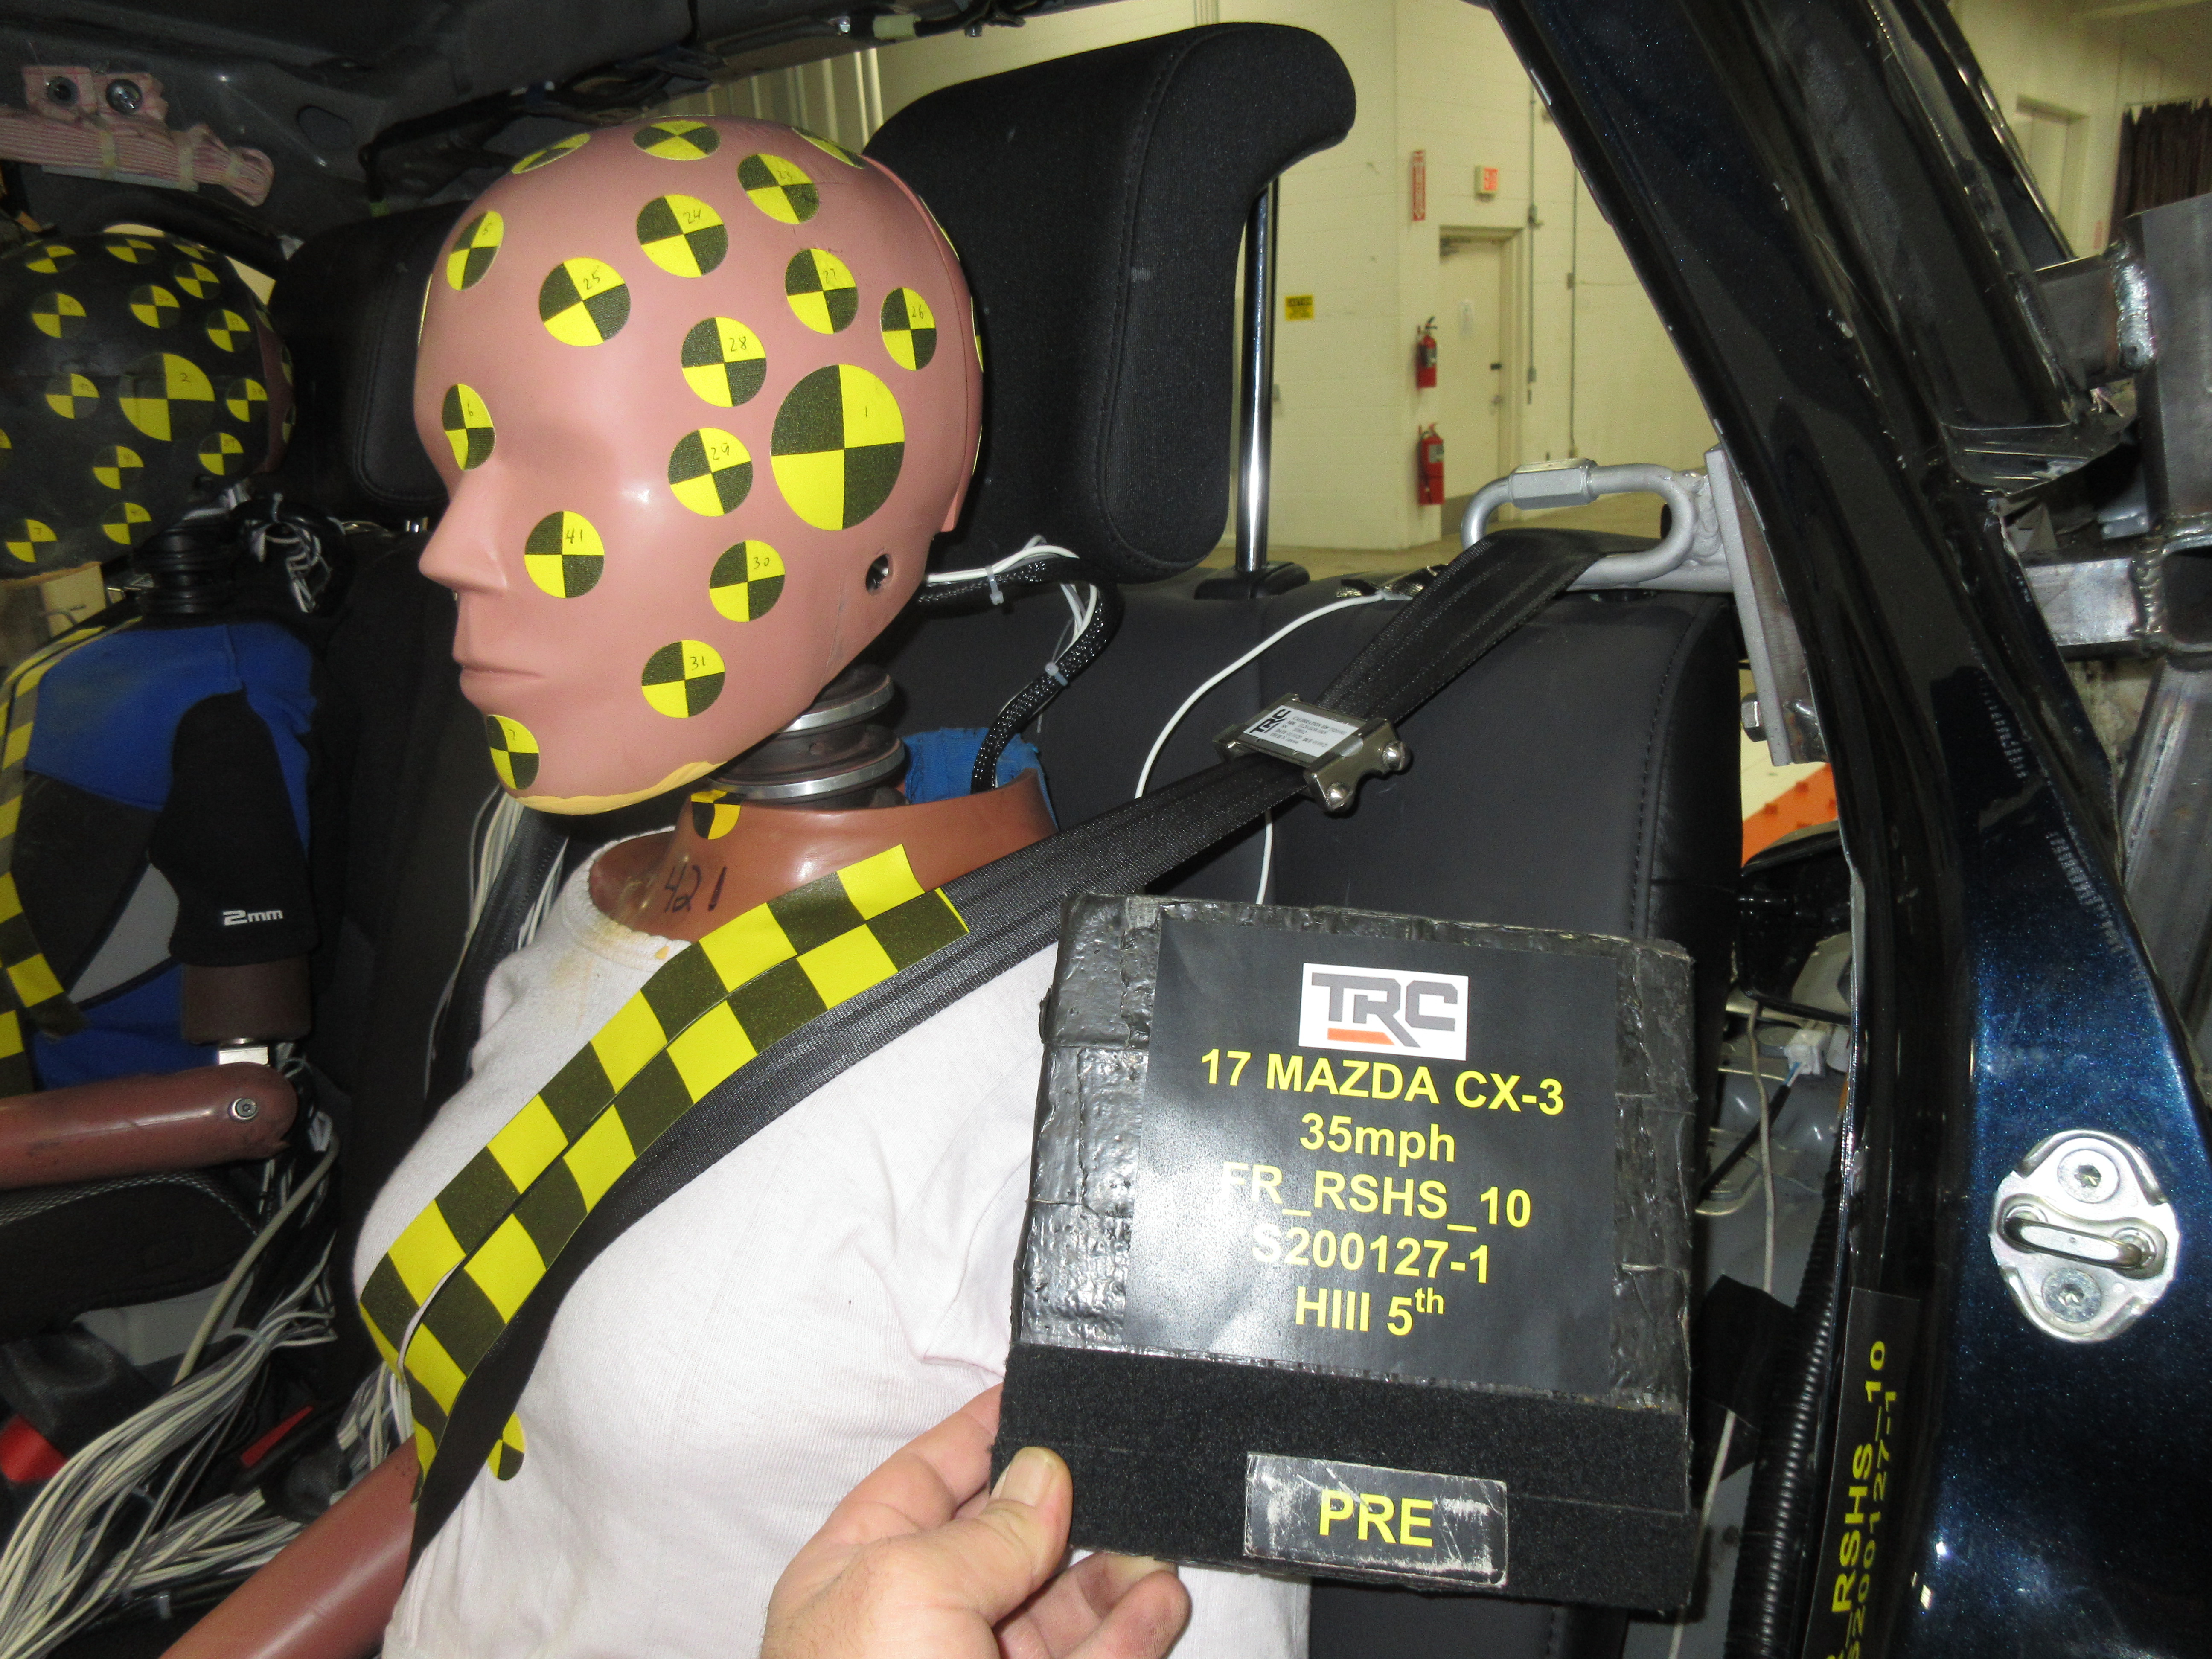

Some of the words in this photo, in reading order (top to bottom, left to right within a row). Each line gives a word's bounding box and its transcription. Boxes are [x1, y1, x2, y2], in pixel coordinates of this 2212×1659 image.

[683, 207, 701, 224] 24
[583, 265, 600, 290] 25
[823, 268, 837, 284] 27
[911, 304, 924, 319] 26
[729, 336, 747, 352] 28
[710, 442, 730, 460] 29
[565, 527, 583, 544] 41
[754, 556, 770, 570] 30
[690, 656, 706, 671] 31
[1249, 708, 1292, 733] TRC
[222, 909, 284, 926] 2mm
[1311, 972, 1458, 1048] TRC
[1201, 1048, 1251, 1087] 17
[1266, 1053, 1440, 1104] MAZDA
[1455, 1070, 1564, 1115] CX-3
[1299, 1112, 1455, 1168] 35mph
[1221, 1161, 1531, 1233] FR_RSHS_10
[1252, 1223, 1489, 1284] S200127-1
[1386, 1287, 1444, 1337] 5th
[1318, 1489, 1434, 1548] PRE
